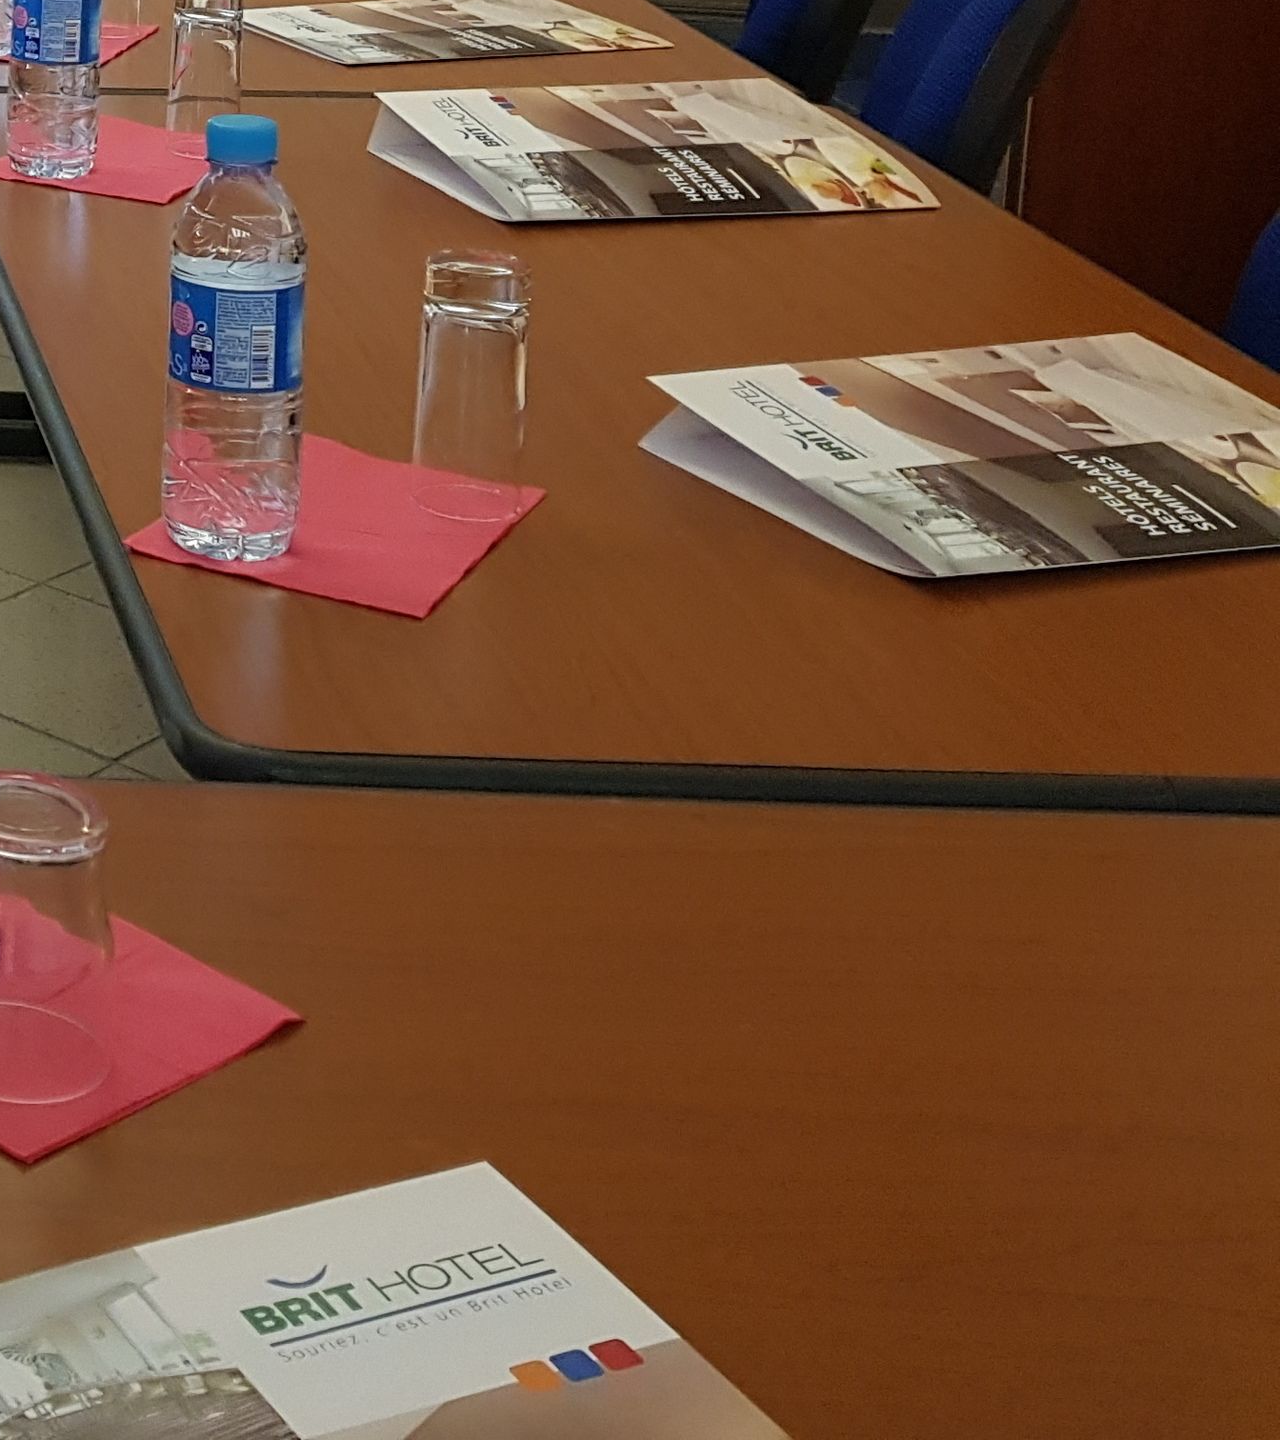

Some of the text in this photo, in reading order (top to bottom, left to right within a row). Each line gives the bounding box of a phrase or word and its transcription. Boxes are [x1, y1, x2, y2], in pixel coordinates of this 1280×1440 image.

[653, 148, 724, 200] RESTAURANT
[729, 380, 858, 461] BRIT HOTEL
[1057, 454, 1193, 534] RESTAURANT
[240, 1243, 545, 1335] BRIT HOTEL
[439, 1305, 462, 1323] un
[468, 1293, 508, 1314] Brit
[517, 1277, 572, 1300] Hotel
